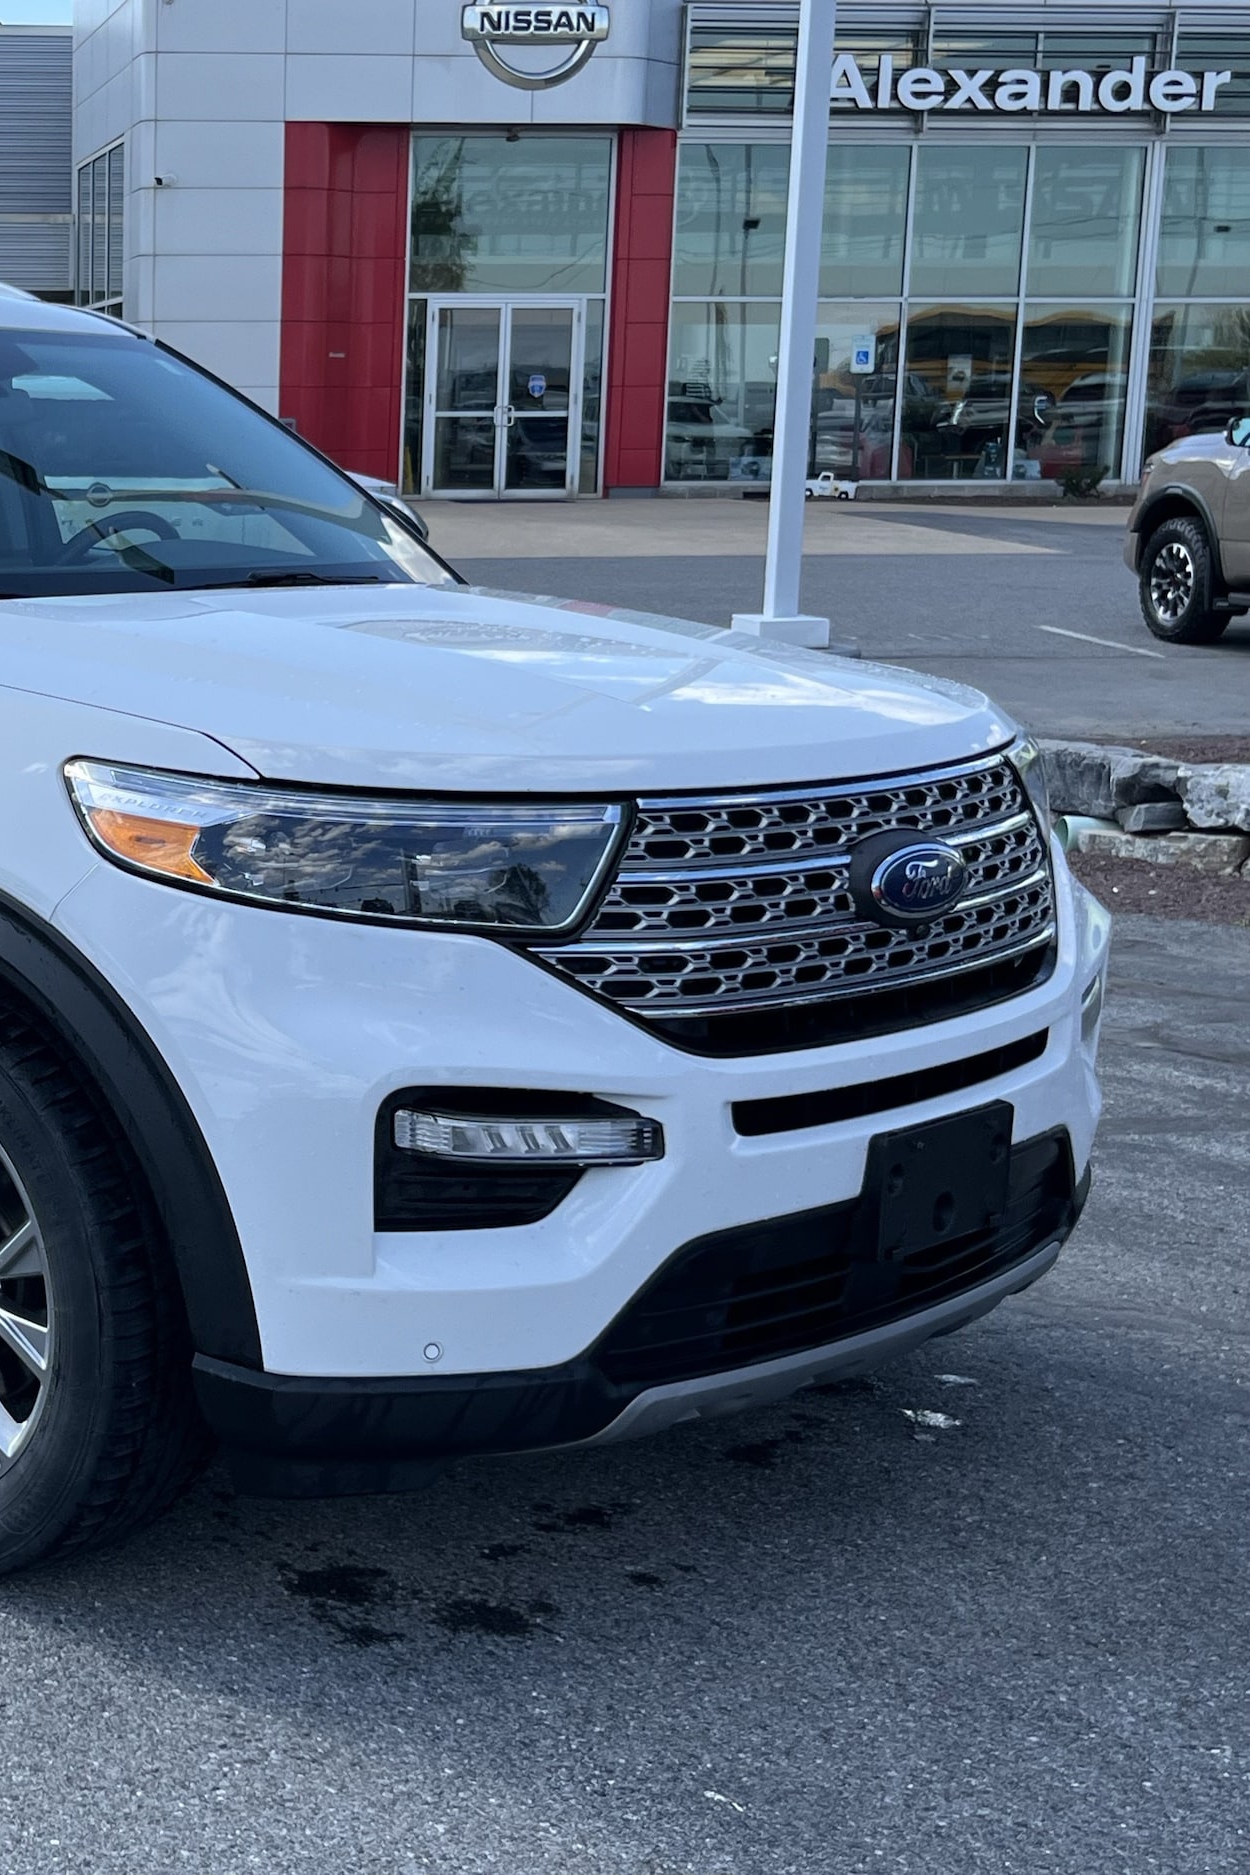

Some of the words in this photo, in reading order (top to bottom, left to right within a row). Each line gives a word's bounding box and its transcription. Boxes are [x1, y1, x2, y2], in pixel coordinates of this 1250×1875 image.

[480, 10, 596, 32] NISSAN
[830, 54, 1232, 112] Alexander
[98, 792, 208, 819] EXPLORER
[902, 859, 952, 899] Ford
